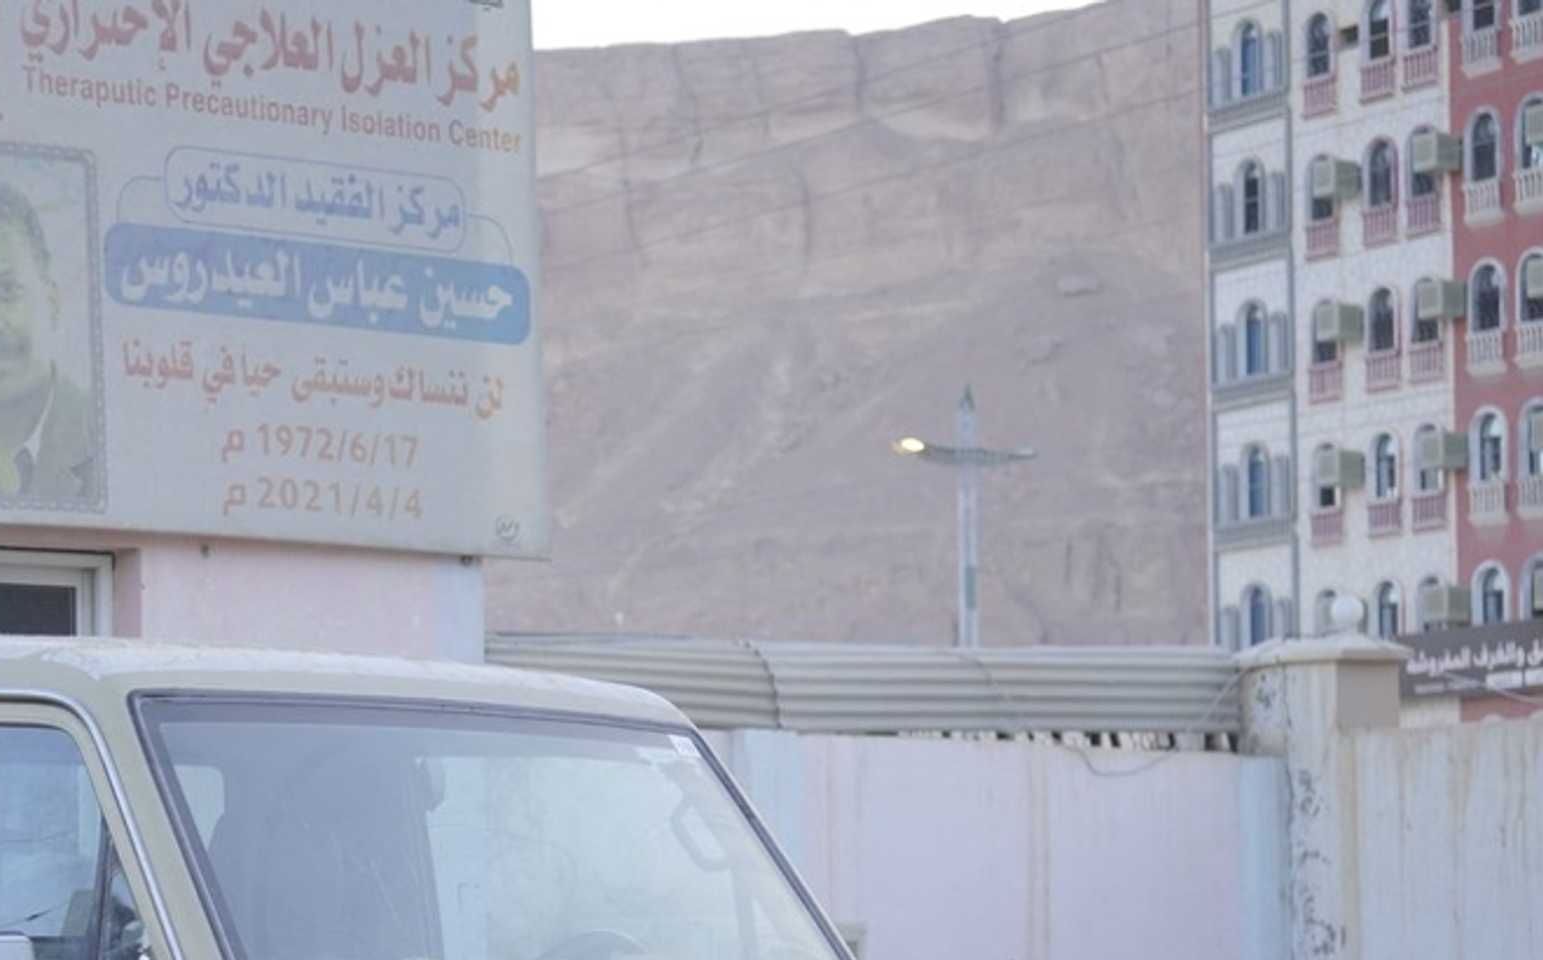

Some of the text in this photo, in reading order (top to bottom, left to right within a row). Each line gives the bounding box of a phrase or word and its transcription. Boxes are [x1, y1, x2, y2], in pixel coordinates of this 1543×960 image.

[203, 8, 334, 88] العلاجي
[340, 21, 432, 97] العزل
[435, 34, 519, 113] مركز
[22, 65, 522, 153] Theraputic Precautionary Isolation Center
[172, 162, 460, 239] مركز الفقيد الدكتور
[121, 246, 514, 329] حسين عباس العيدروس
[123, 338, 194, 389] قلوبنا
[202, 346, 235, 404] في
[389, 365, 468, 407] ننساك
[475, 375, 503, 420] لن
[256, 423, 419, 467] 1972/6/17
[256, 476, 423, 520] 2021/4/4
